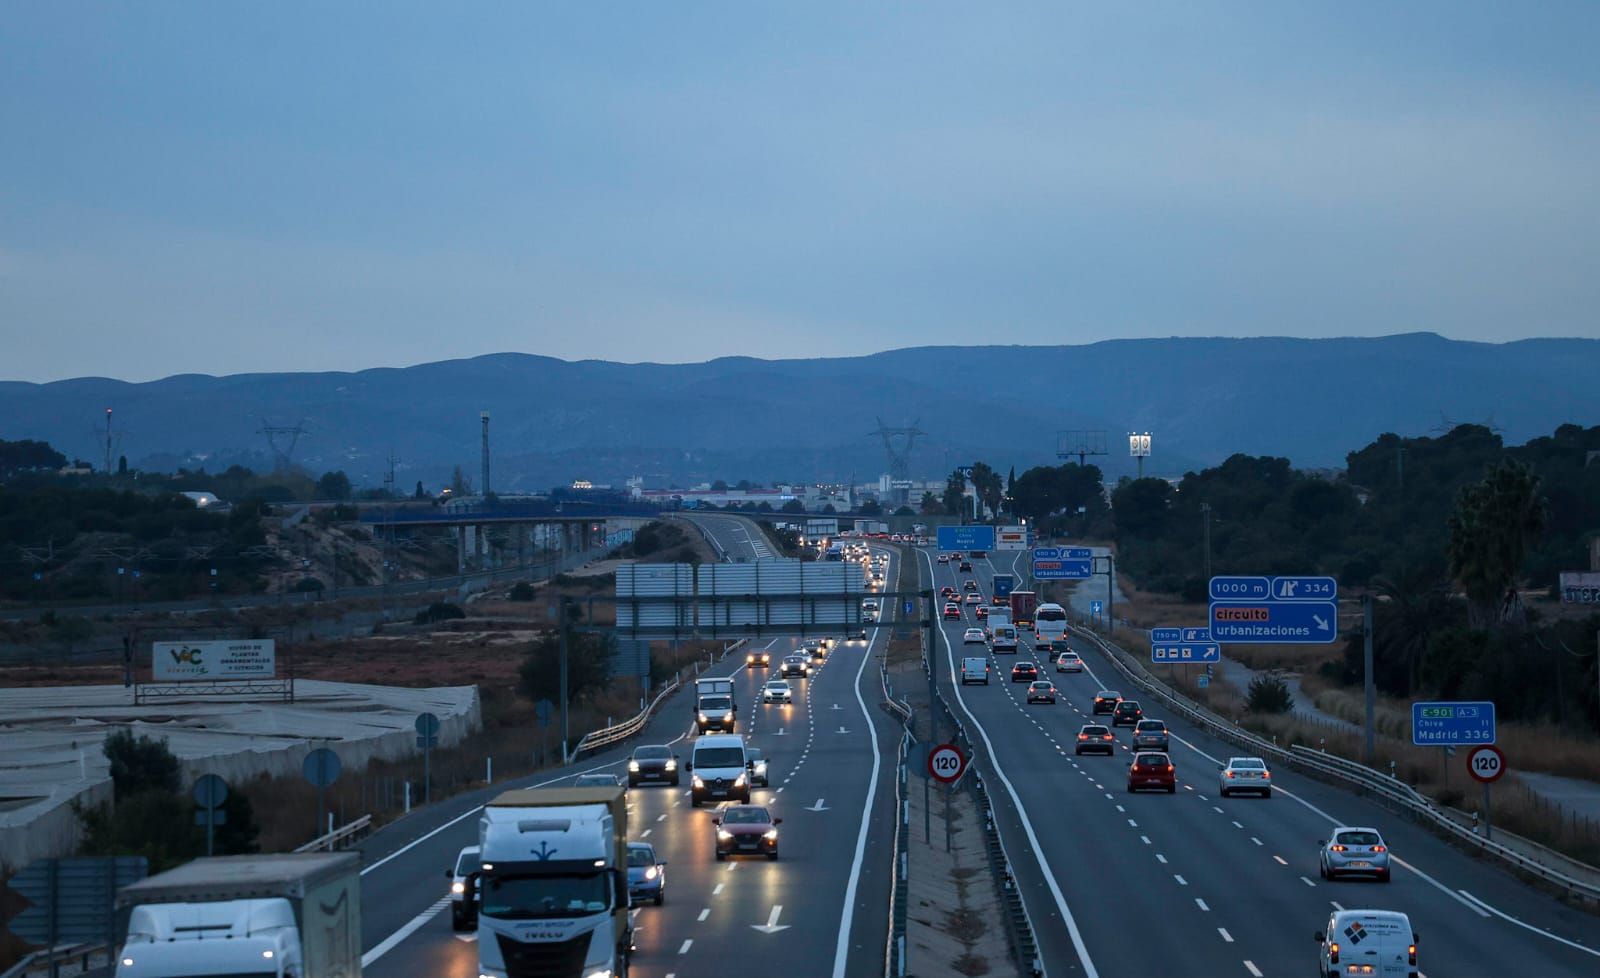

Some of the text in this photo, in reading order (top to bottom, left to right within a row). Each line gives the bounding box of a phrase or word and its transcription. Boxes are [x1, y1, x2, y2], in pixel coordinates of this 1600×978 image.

[1216, 583, 1264, 593] 1000 m
[1304, 584, 1330, 593] 334
[1216, 609, 1269, 620] circuito
[1216, 625, 1310, 636] urbanizaciones
[1422, 709, 1453, 717] E-901
[1459, 708, 1478, 717] A-3
[1418, 719, 1489, 727] Chiva 11
[1418, 730, 1490, 739] Madrid 336
[935, 757, 958, 770] 120
[1474, 757, 1499, 770] 120
[525, 930, 565, 939] IVECO
